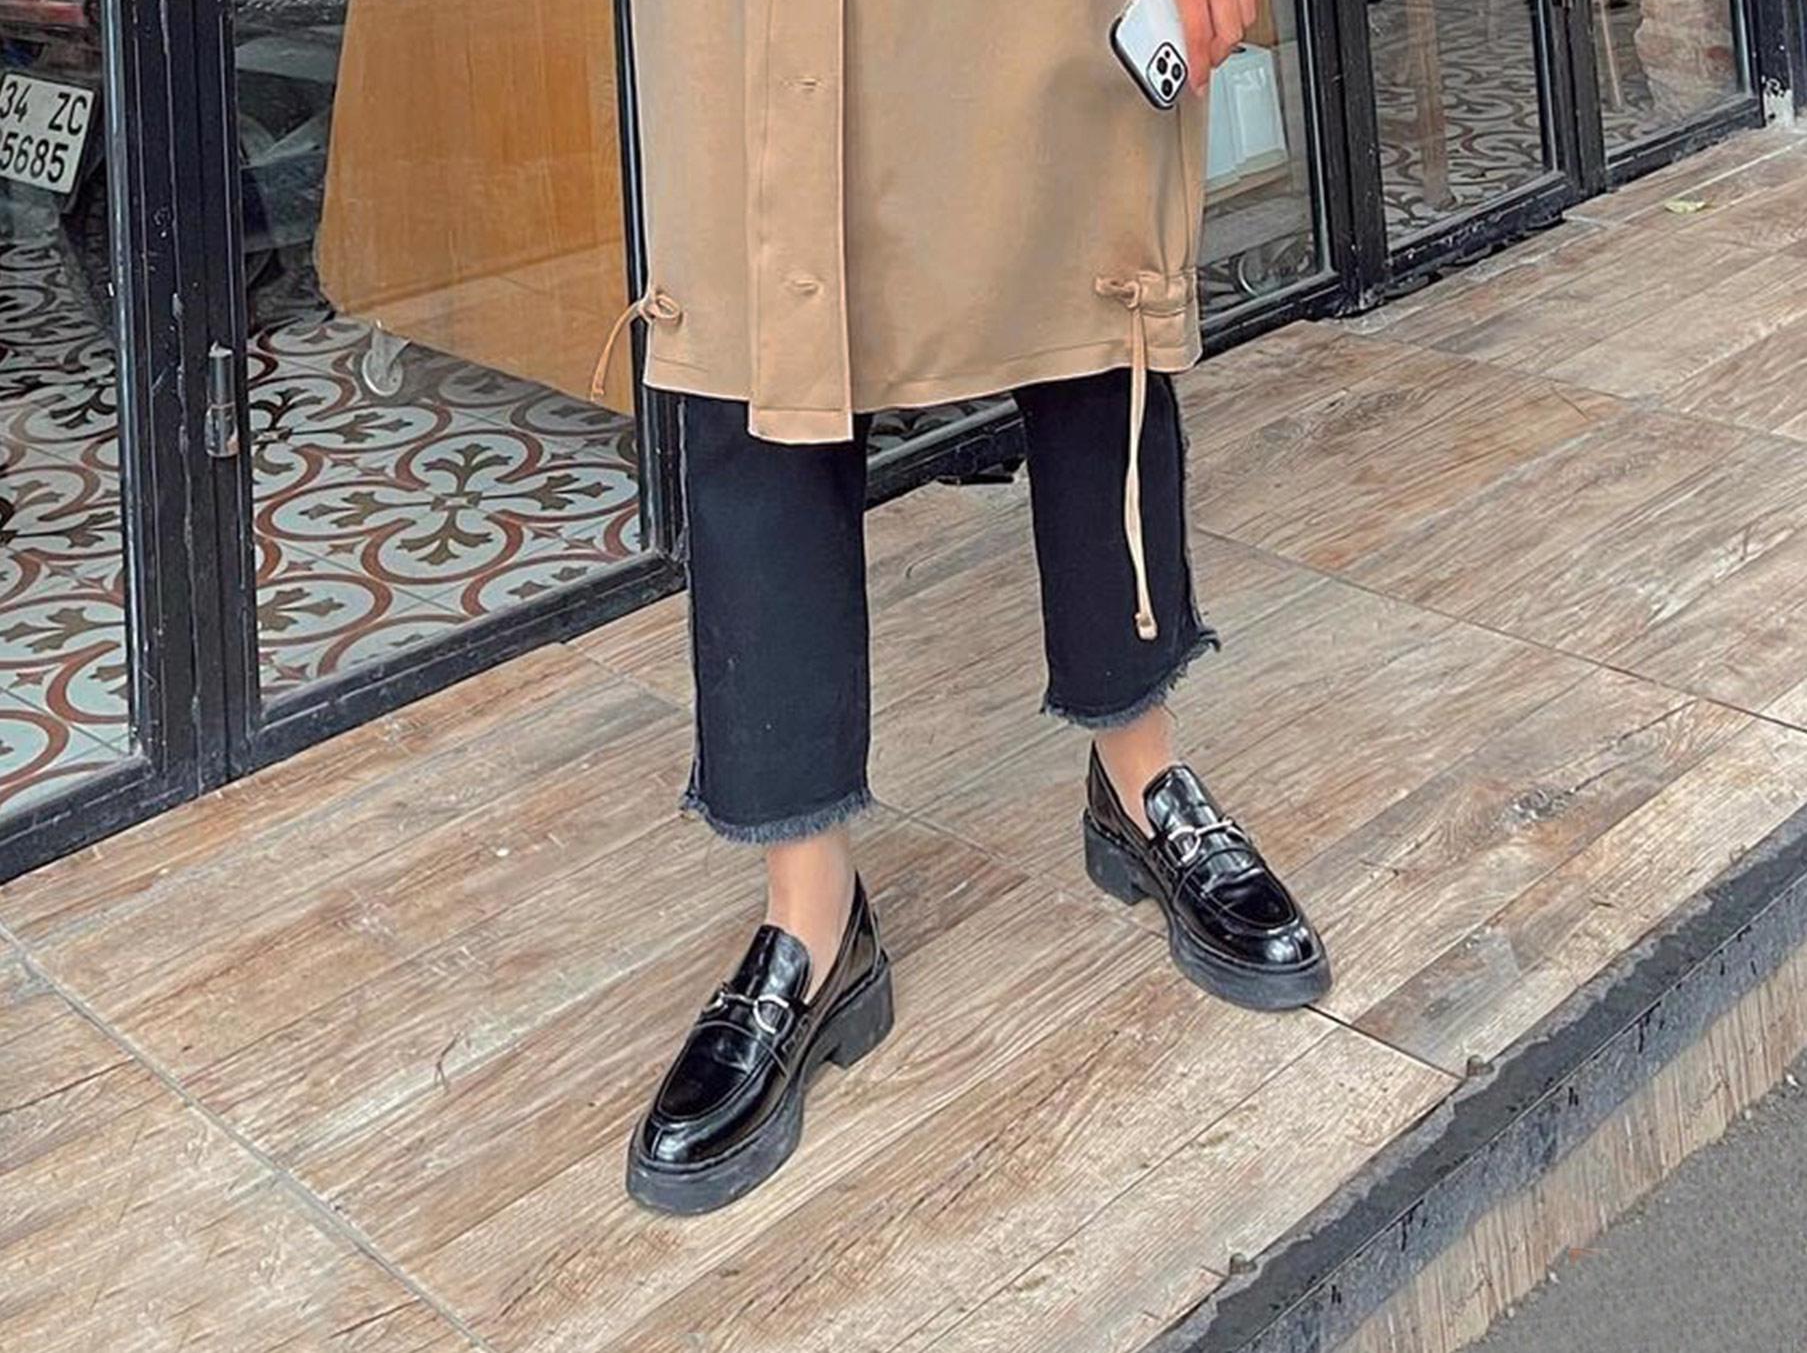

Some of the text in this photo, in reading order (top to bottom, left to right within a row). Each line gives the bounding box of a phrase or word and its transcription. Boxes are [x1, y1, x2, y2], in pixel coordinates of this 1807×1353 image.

[0, 81, 87, 135] 34 ZC
[0, 132, 69, 183] 5685
